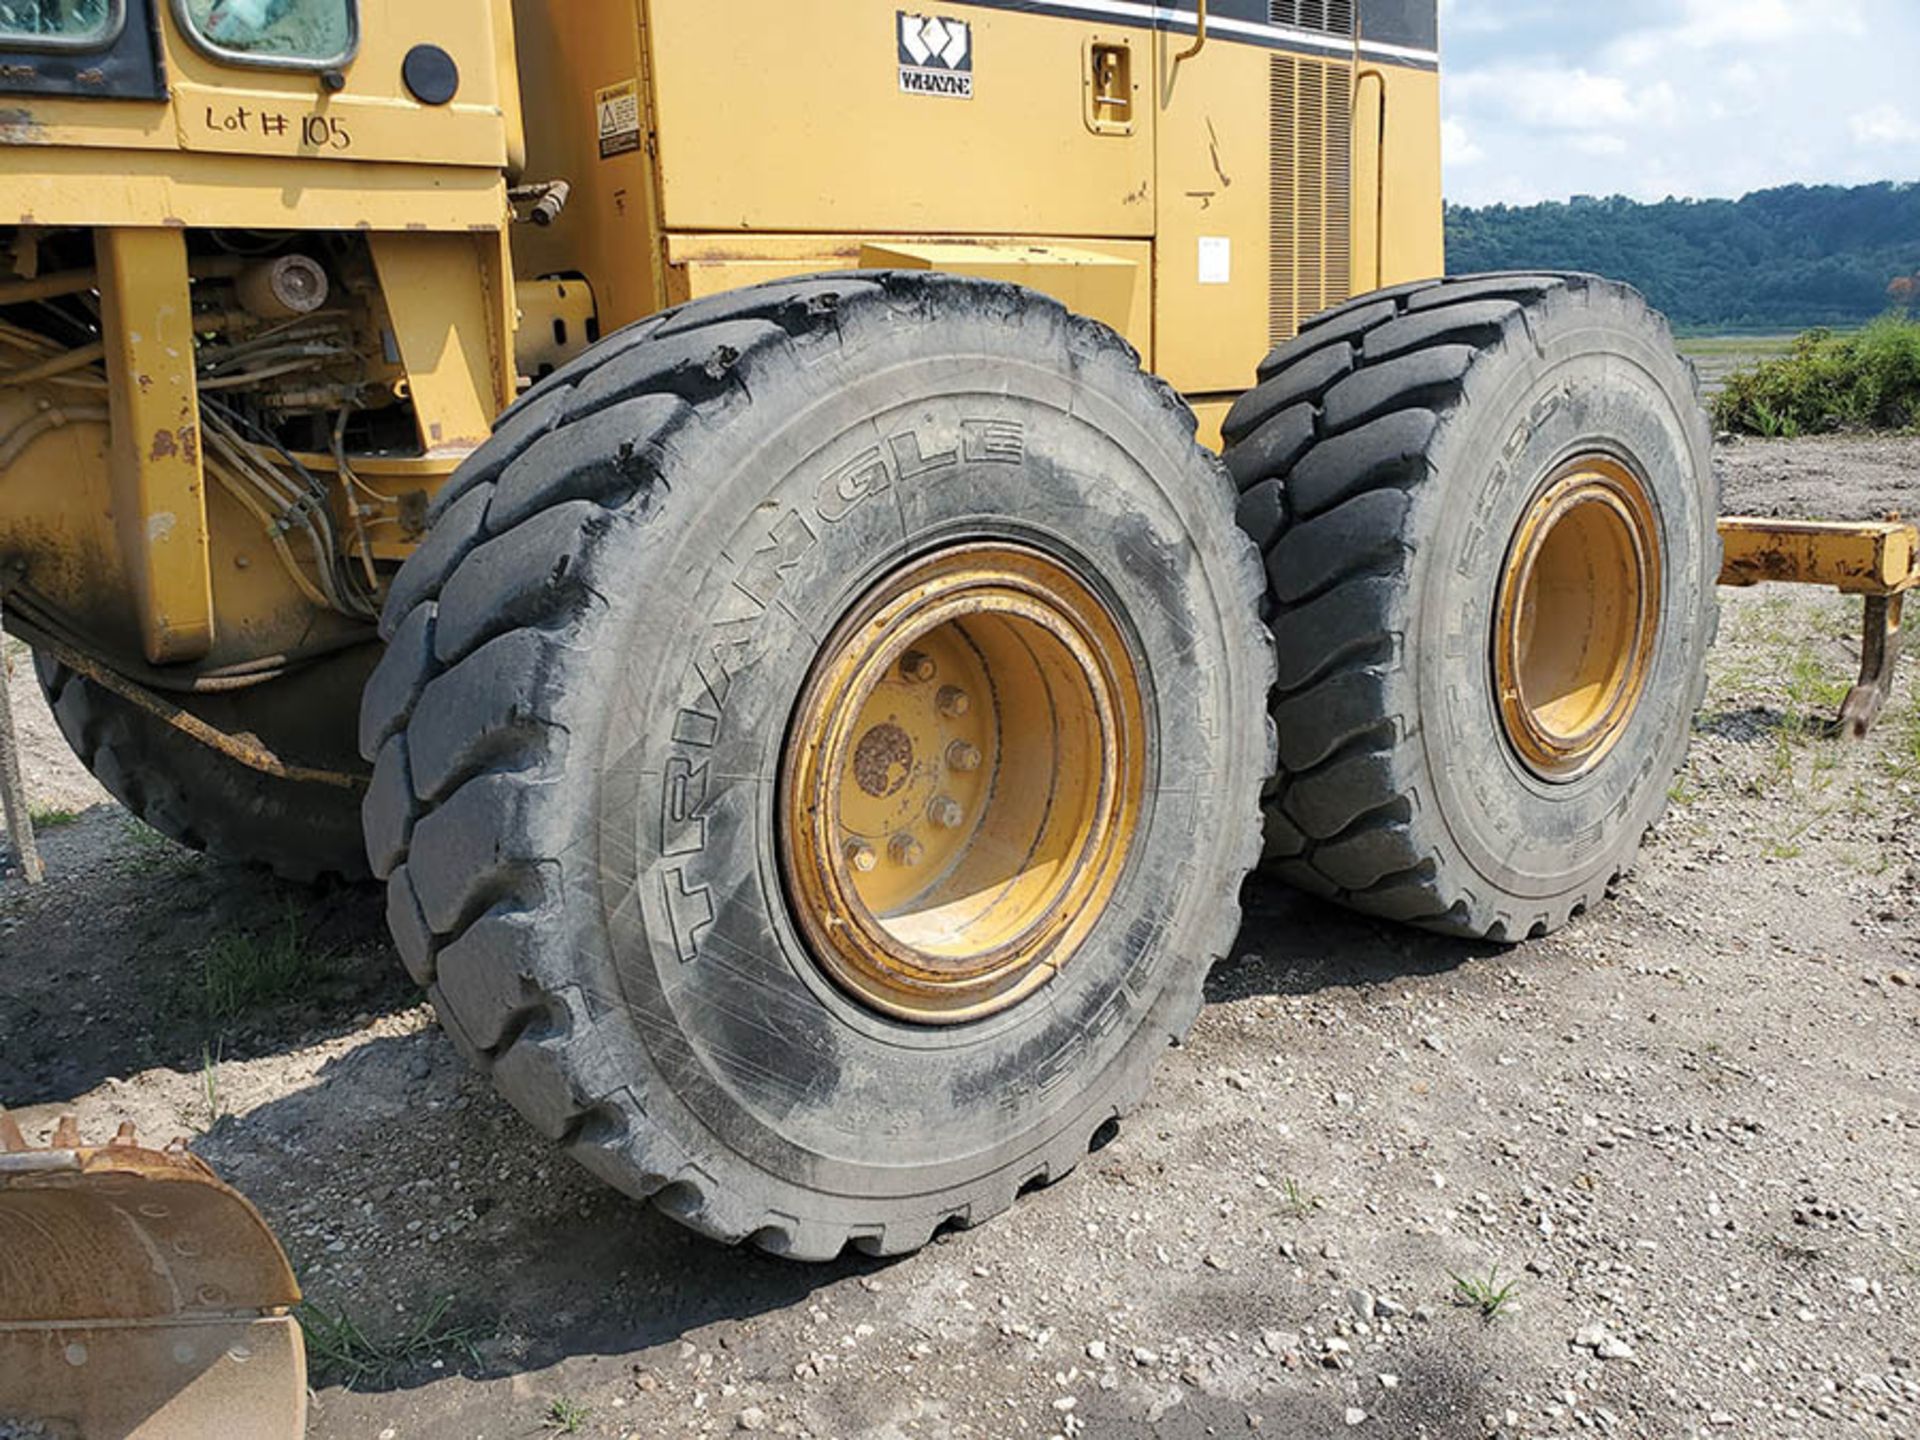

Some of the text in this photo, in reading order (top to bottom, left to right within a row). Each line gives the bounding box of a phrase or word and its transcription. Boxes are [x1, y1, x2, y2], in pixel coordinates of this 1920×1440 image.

[901, 71, 970, 95] WHAYNE
[205, 105, 351, 150] Lot # 105
[661, 417, 1024, 964] TRIANGLE
